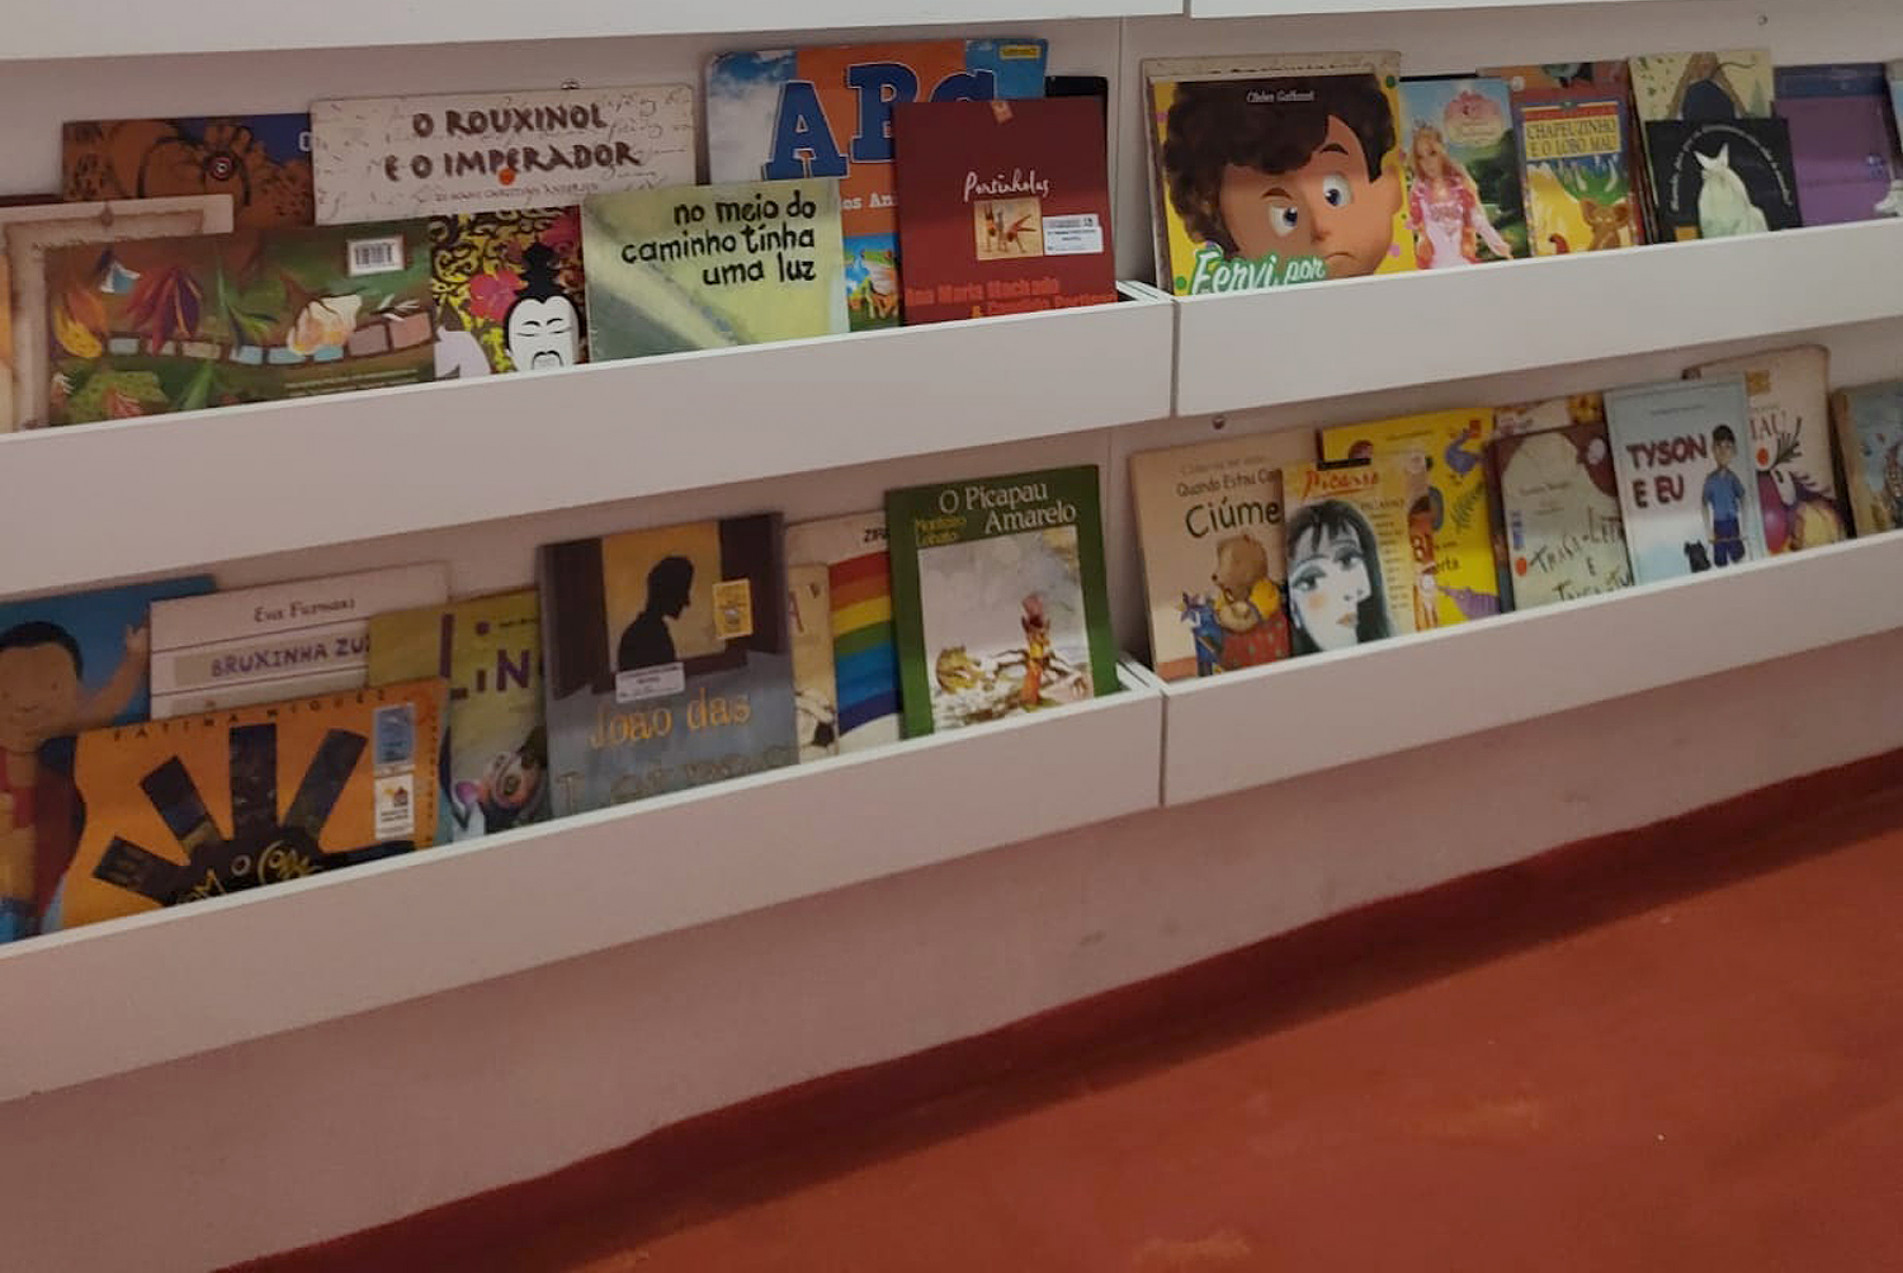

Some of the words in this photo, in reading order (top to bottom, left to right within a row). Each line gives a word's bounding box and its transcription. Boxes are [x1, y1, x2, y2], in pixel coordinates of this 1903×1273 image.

[413, 112, 435, 139] O
[445, 101, 608, 137] ROUXINOL
[384, 155, 400, 183] E
[410, 152, 433, 179] O
[444, 140, 641, 177] IMPERADOR
[672, 198, 705, 225] no
[715, 188, 780, 225] meio
[786, 188, 818, 220] do
[620, 230, 739, 265] caminho
[702, 260, 765, 288] uma
[776, 250, 818, 284] luz
[1285, 255, 1327, 284] por
[1625, 432, 1708, 470] TYSON
[938, 488, 961, 515] O
[964, 482, 1049, 511] Picapau
[1631, 479, 1649, 510] E
[1652, 473, 1685, 505] EU
[983, 499, 1077, 535] Amarelo
[1185, 495, 1282, 539] Ciúme
[253, 605, 284, 623] Eva
[289, 597, 356, 619] Furnari
[210, 642, 328, 678] BRUXINHA
[686, 685, 751, 733] das
